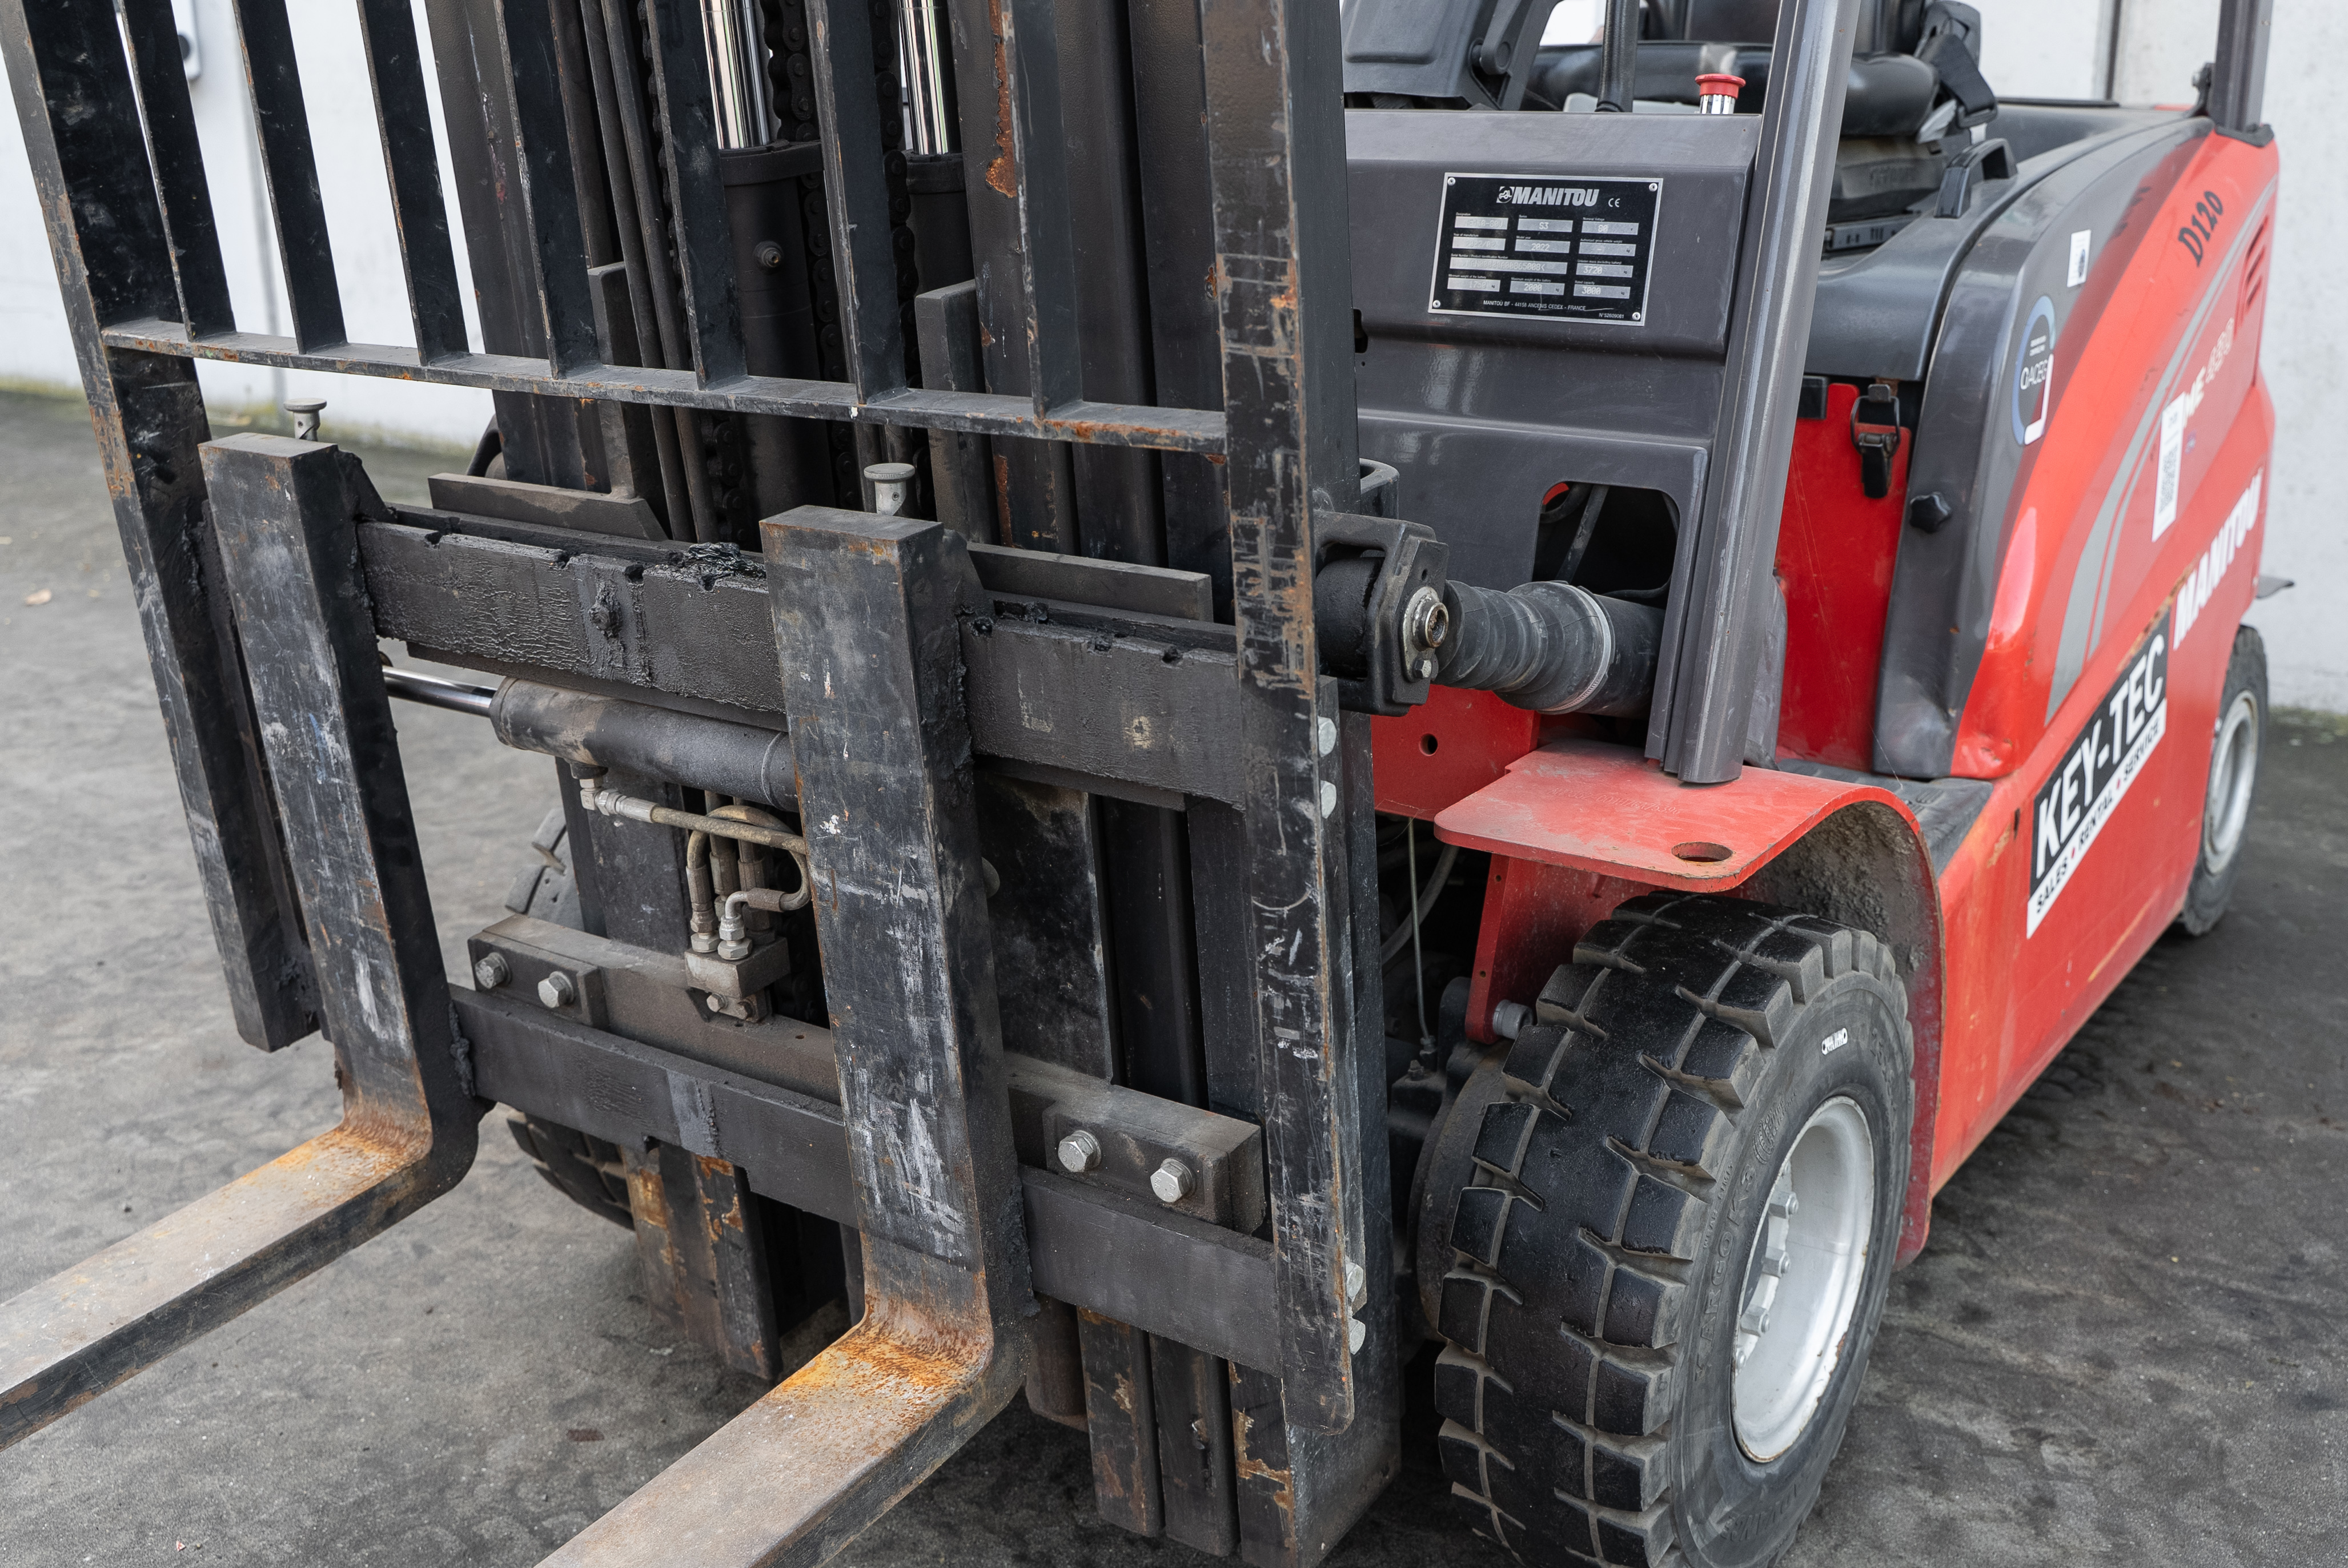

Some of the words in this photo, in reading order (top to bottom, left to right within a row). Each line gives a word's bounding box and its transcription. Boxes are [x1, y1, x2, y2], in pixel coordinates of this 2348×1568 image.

[1511, 186, 1599, 207] MANITOU
[1608, 198, 1620, 207] CE
[2177, 190, 2224, 268] D120
[1582, 286, 1601, 295] 3000
[1583, 266, 1603, 274] 3720
[2173, 466, 2263, 652] MANITOU
[2036, 633, 2165, 880] KEY-TEC
[2036, 855, 2070, 914] SALES
[2077, 791, 2116, 851] RENTAL
[2121, 718, 2161, 783] SERVICE
